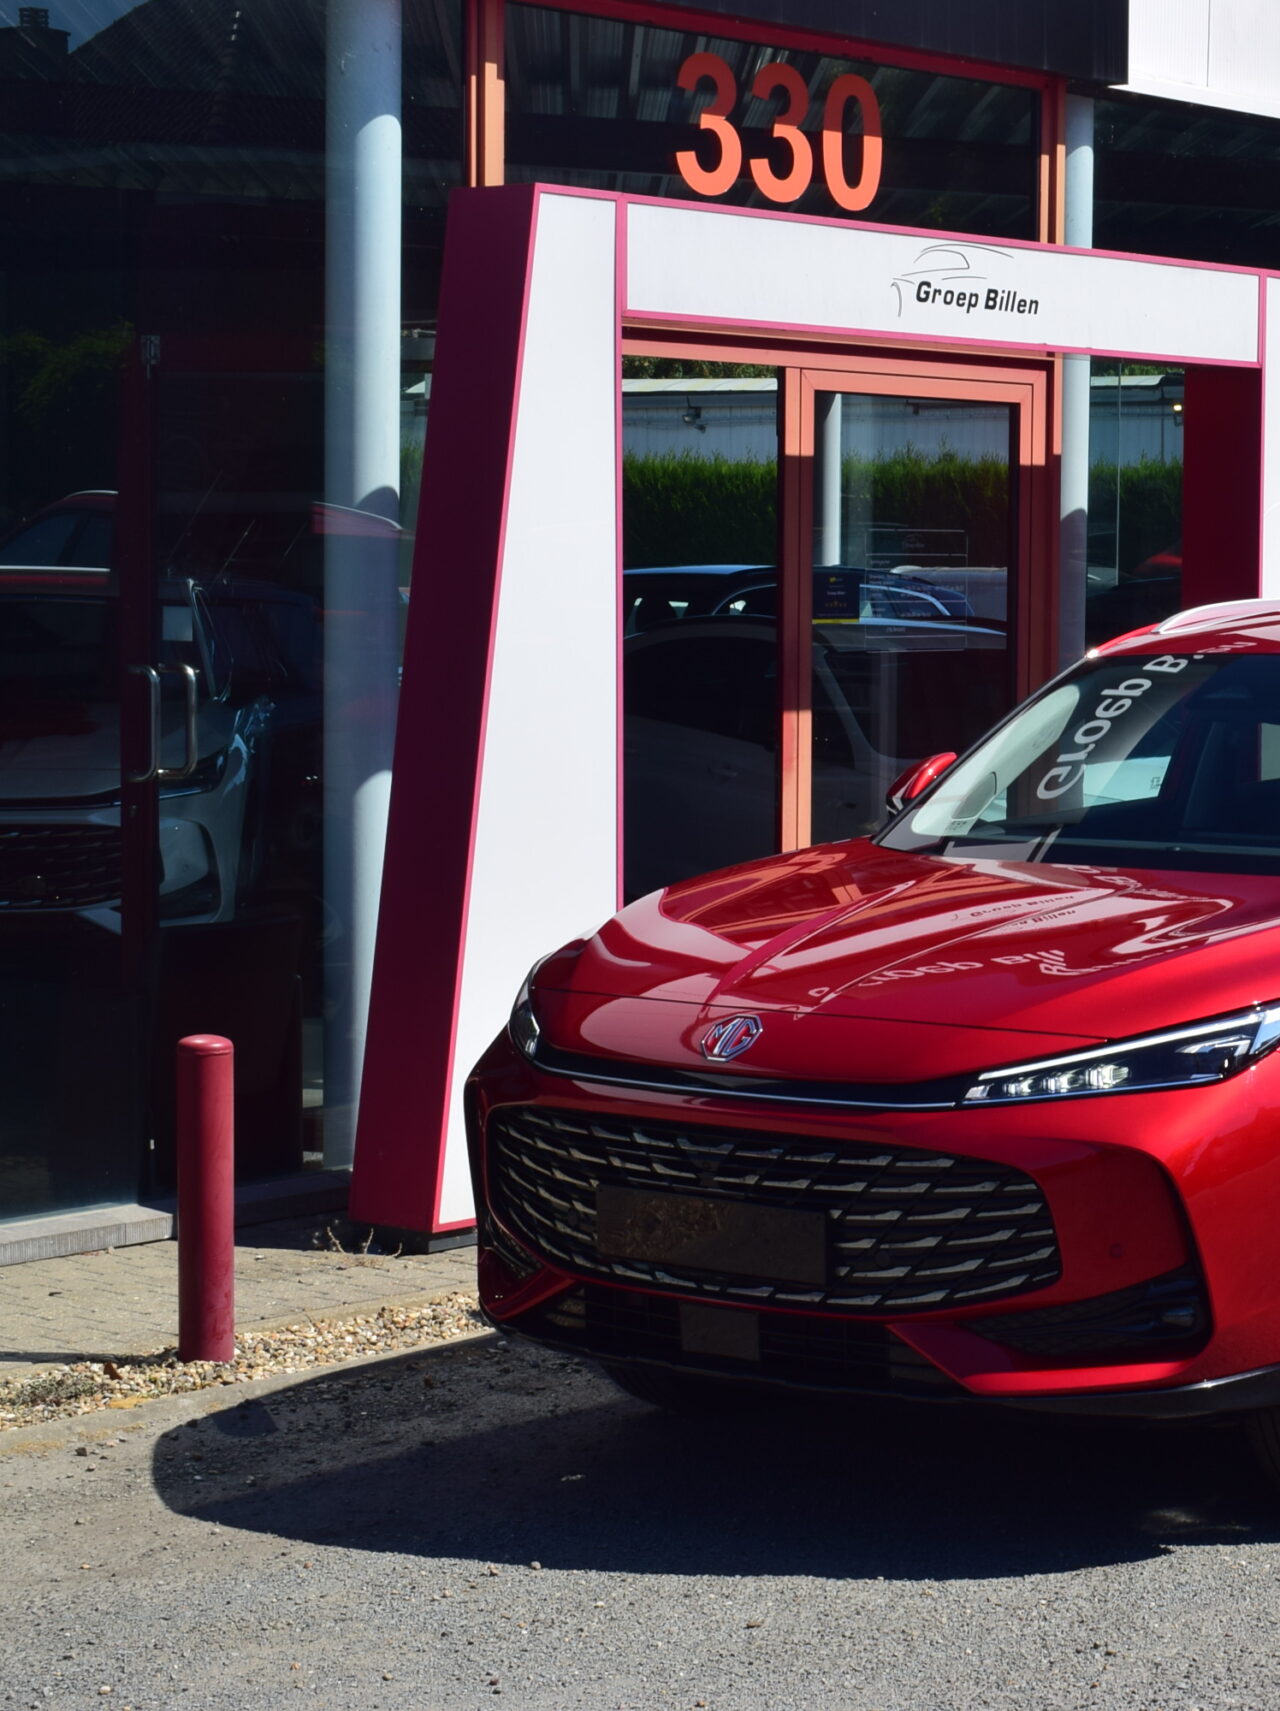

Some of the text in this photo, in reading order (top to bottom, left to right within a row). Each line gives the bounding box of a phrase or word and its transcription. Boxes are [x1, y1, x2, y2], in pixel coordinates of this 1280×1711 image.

[675, 52, 883, 211] 330
[915, 280, 1039, 315] Groep Billen
[706, 1016, 758, 1057] MG
